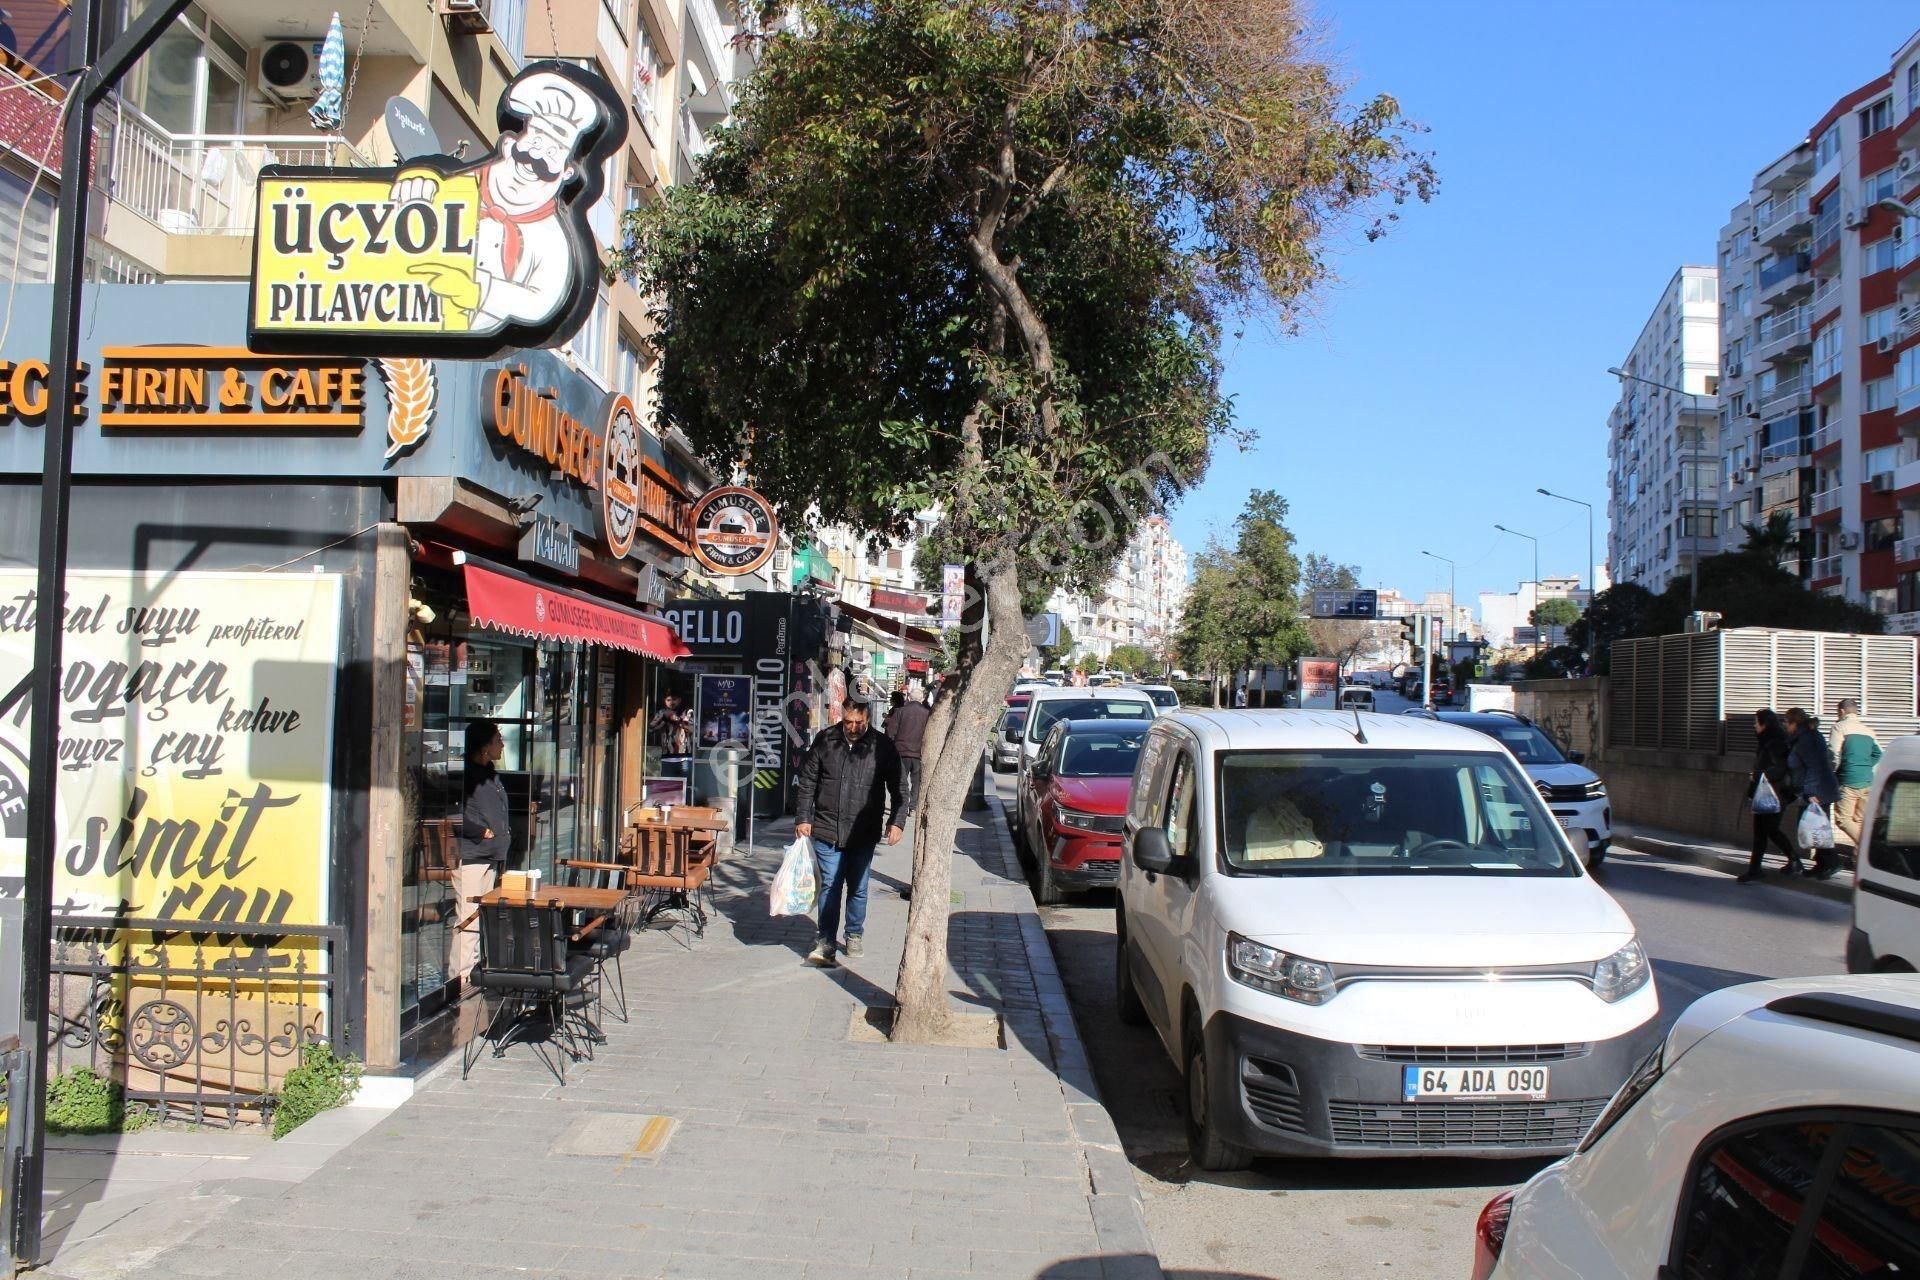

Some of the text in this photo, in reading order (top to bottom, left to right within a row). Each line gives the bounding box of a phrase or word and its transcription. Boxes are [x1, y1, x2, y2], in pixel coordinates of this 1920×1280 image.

[273, 188, 473, 270] ÜÇYOL
[270, 272, 441, 323] PİLAVCIM
[101, 368, 205, 406] FIRIN
[219, 367, 247, 407] &
[260, 367, 362, 407] CAFE
[705, 546, 727, 564] FIRIN
[736, 549, 758, 564] CAFE
[116, 606, 201, 648] suyu
[206, 616, 304, 648] profiterol
[656, 609, 743, 644] GELLO
[217, 696, 301, 734] kahve
[755, 657, 785, 769] BARGELLO
[57, 727, 125, 772] oyoz
[141, 731, 225, 780] çay
[65, 783, 302, 880] simit
[1423, 1069, 1544, 1093] 64 ADA 090
